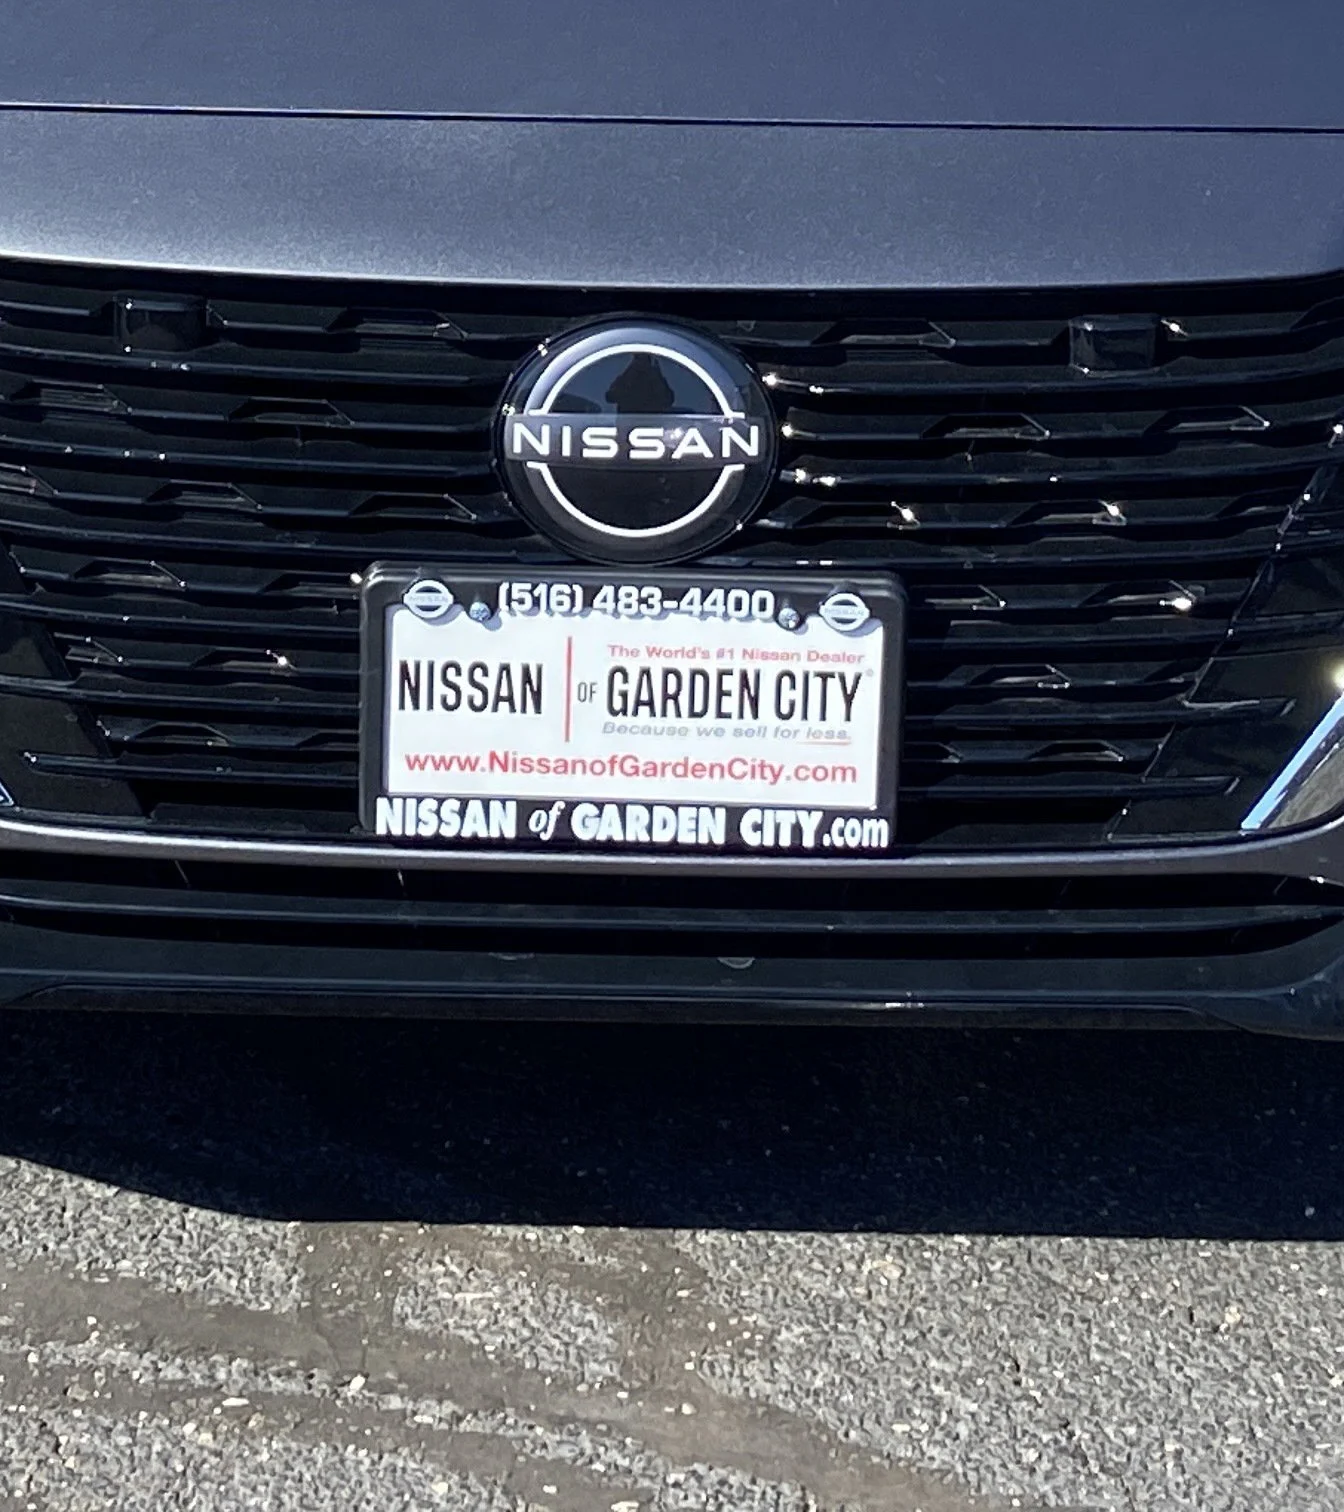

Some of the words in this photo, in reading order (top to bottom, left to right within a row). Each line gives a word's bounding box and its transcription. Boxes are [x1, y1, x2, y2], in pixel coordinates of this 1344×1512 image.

[512, 422, 759, 460] NISSAN
[498, 581, 584, 614] (516)
[592, 584, 775, 619] 483-4400
[607, 644, 640, 659] The
[646, 645, 711, 660] World's
[716, 647, 735, 660] #1
[742, 648, 802, 662] Nissan
[807, 649, 865, 664] Dealer
[398, 659, 544, 715] NISSAN
[577, 682, 599, 703] OF
[607, 664, 761, 720] GARDEN
[774, 669, 863, 722] CITY
[602, 721, 689, 738] Because
[696, 726, 726, 739] we
[732, 725, 768, 739] sell
[773, 726, 800, 740] for
[405, 750, 858, 786] www.NissanofGardenCity.com
[375, 796, 518, 839] NISSAN
[528, 800, 566, 841] of
[570, 802, 727, 846] GARDEN
[739, 807, 889, 849] CITY.com
